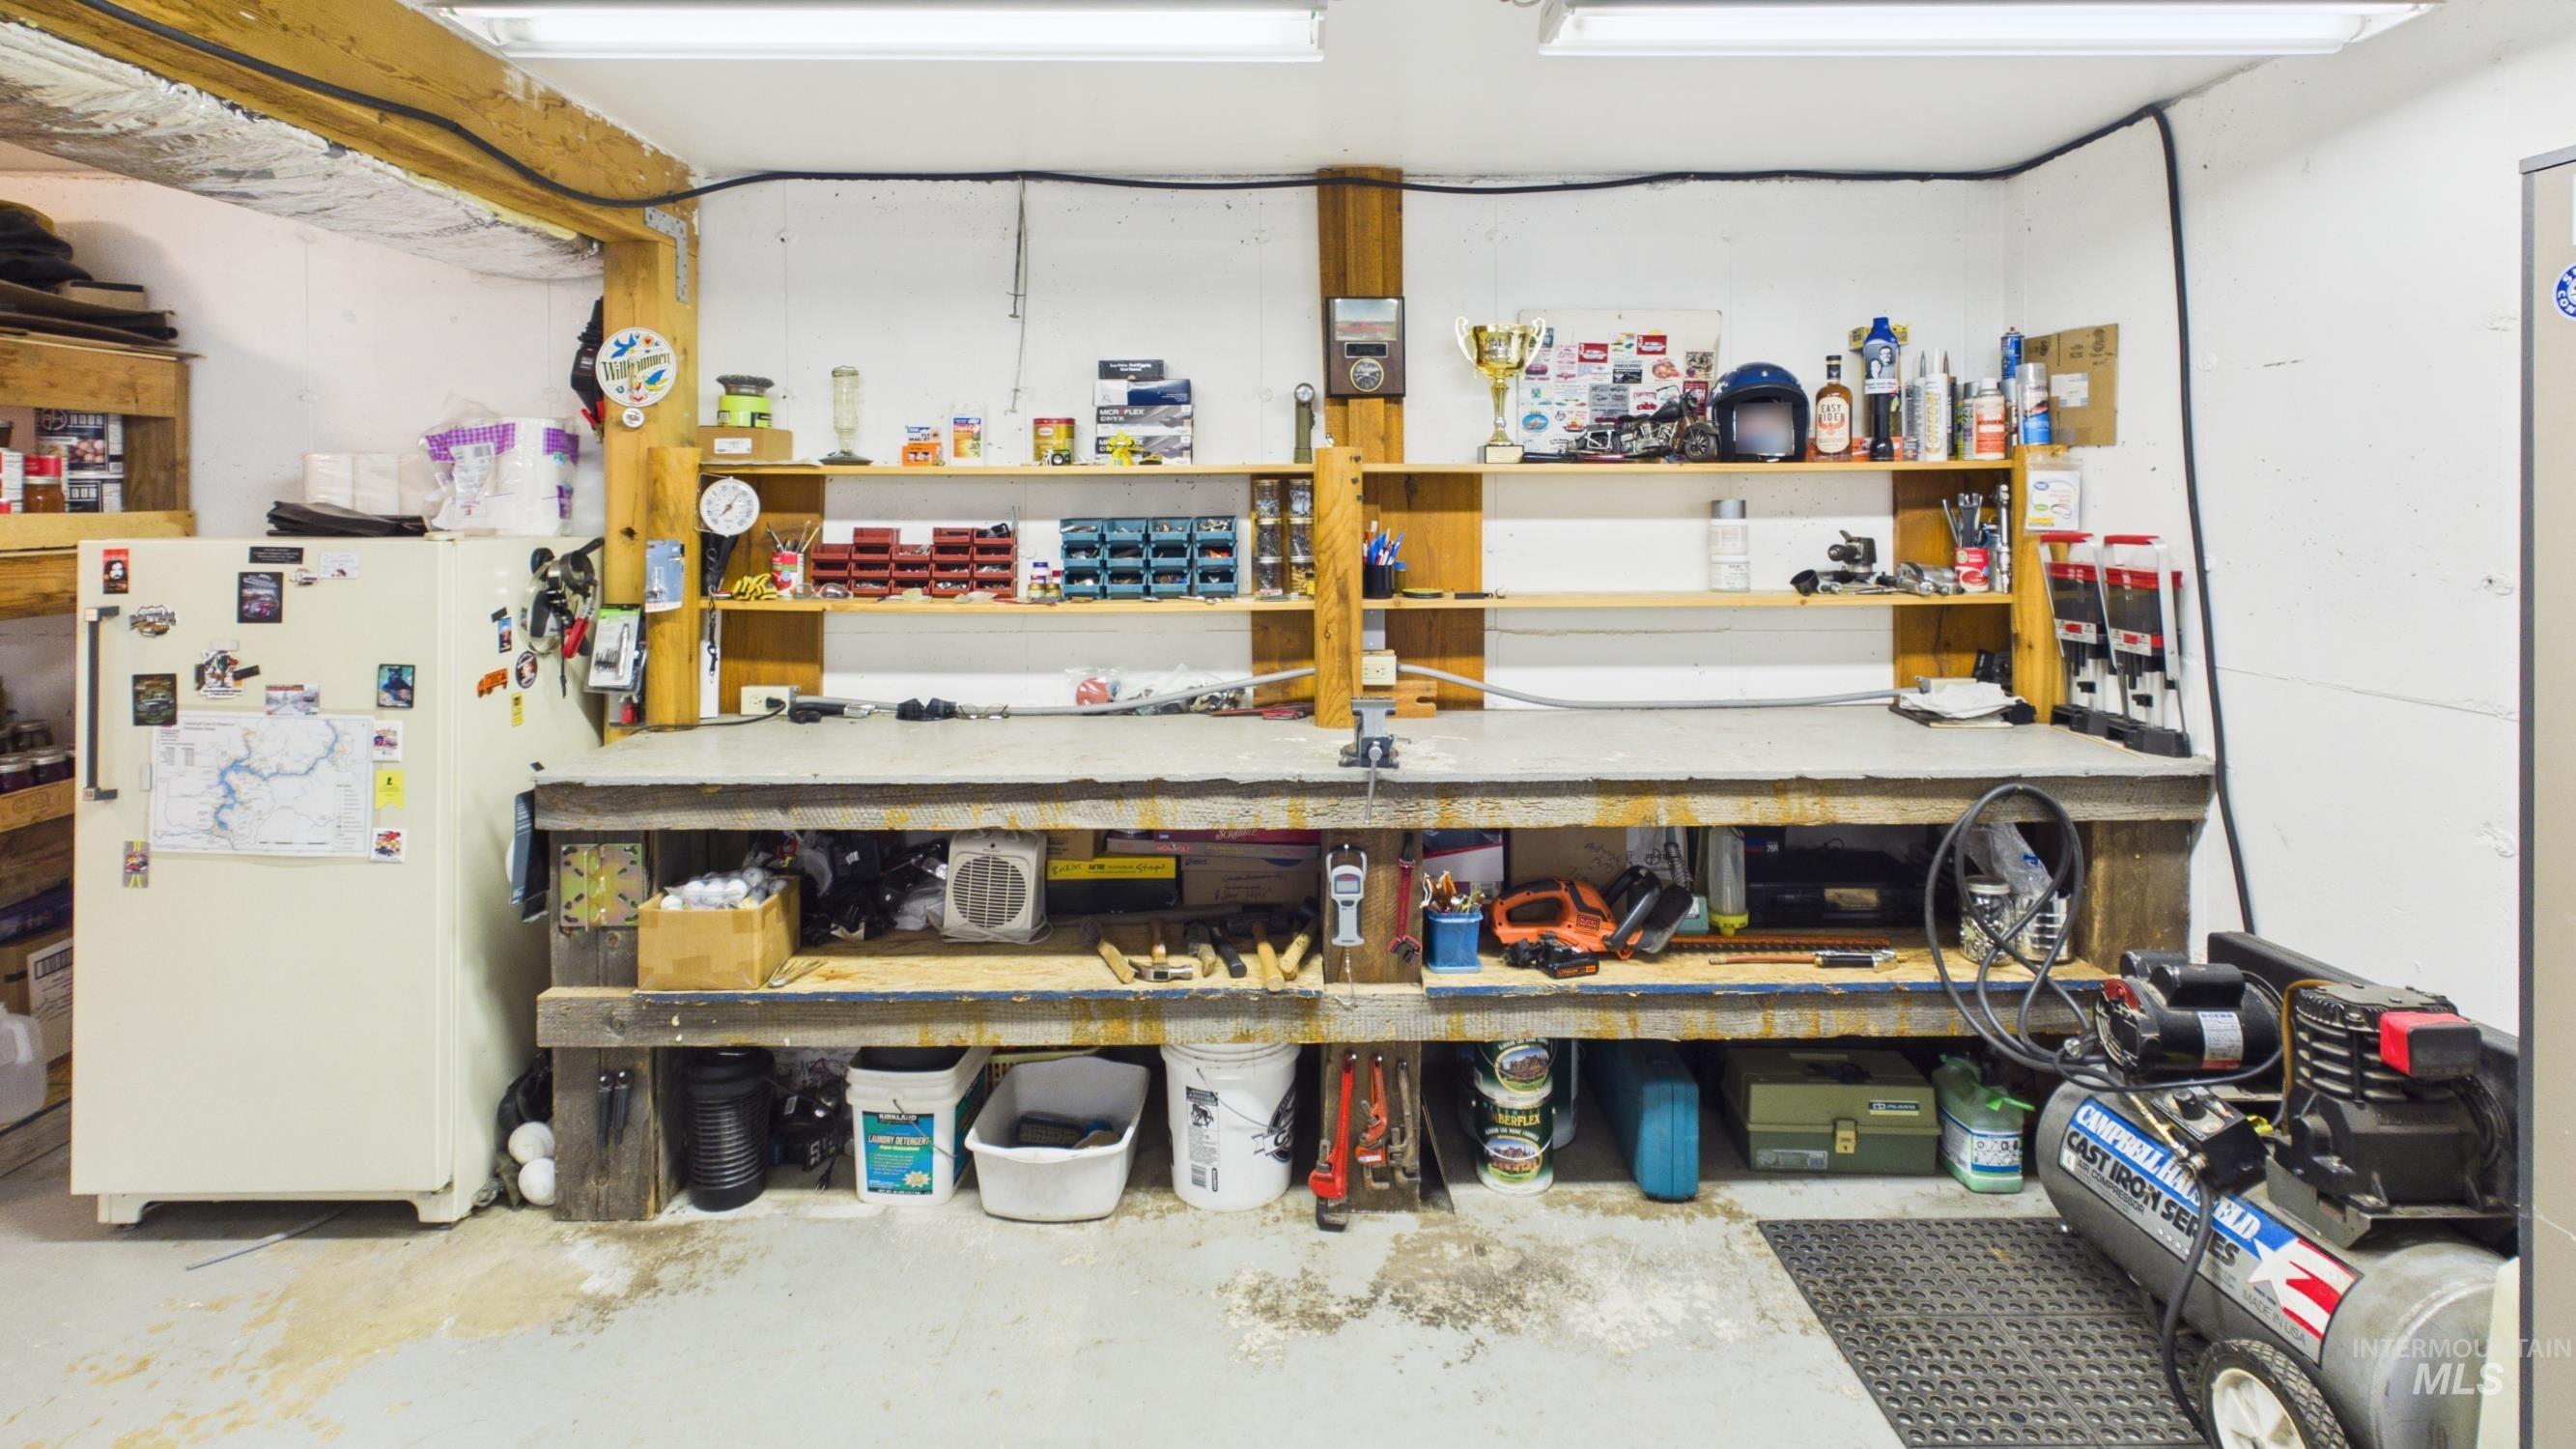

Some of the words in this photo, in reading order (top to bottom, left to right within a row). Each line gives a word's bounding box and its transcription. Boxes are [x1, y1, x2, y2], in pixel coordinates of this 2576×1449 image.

[1818, 412, 1845, 422] RIDER
[1821, 404, 1842, 412] EASY
[69, 488, 97, 498] OUR
[868, 1134, 894, 1145] LAUNDRY
[895, 1136, 929, 1146] DETERGENT
[2076, 1104, 2164, 1177] CAMPBELL
[2155, 1157, 2261, 1240] HAUELD
[2077, 1160, 2089, 1174] AIR
[2091, 1169, 2145, 1215] COMPRESSOR
[2067, 1130, 2111, 1172] CAST
[2109, 1160, 2163, 1211] IRON
[2160, 1199, 2241, 1267] SERES
[2243, 1290, 2272, 1318] MADE
[2283, 1318, 2307, 1346] USA
